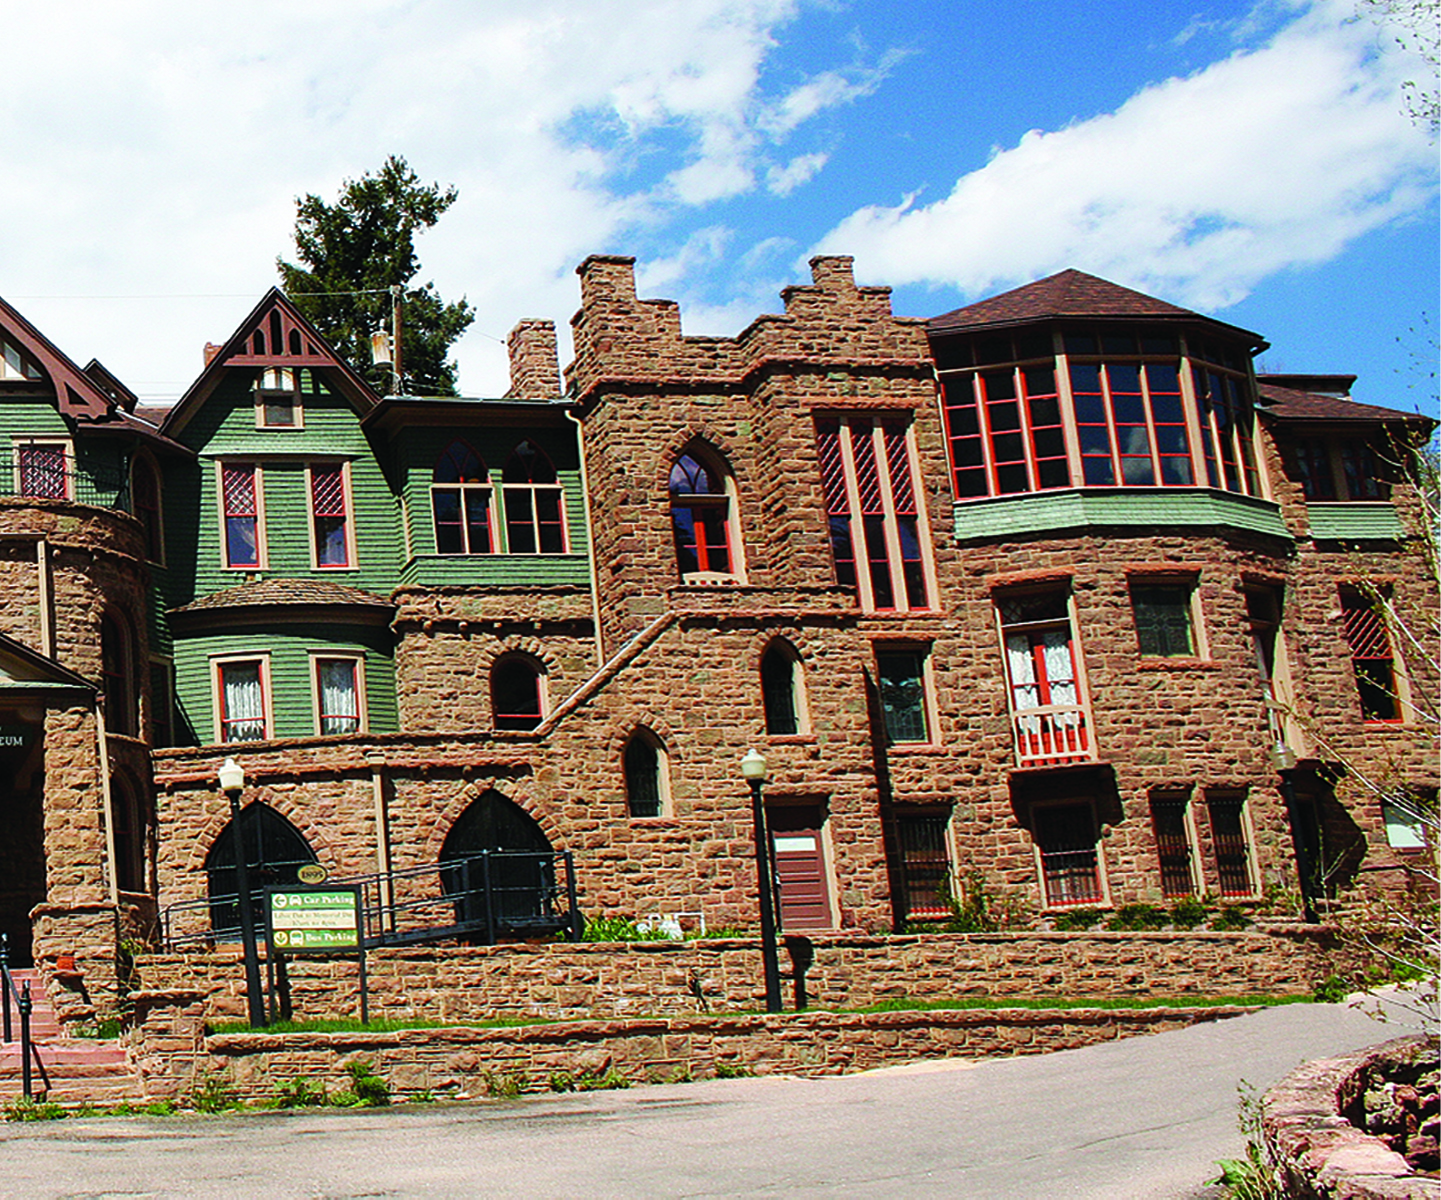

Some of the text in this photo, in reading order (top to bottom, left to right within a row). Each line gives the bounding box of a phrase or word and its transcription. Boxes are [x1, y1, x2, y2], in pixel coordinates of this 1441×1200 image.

[304, 896, 355, 905] Car Parking
[305, 933, 357, 942] Bus Parking
